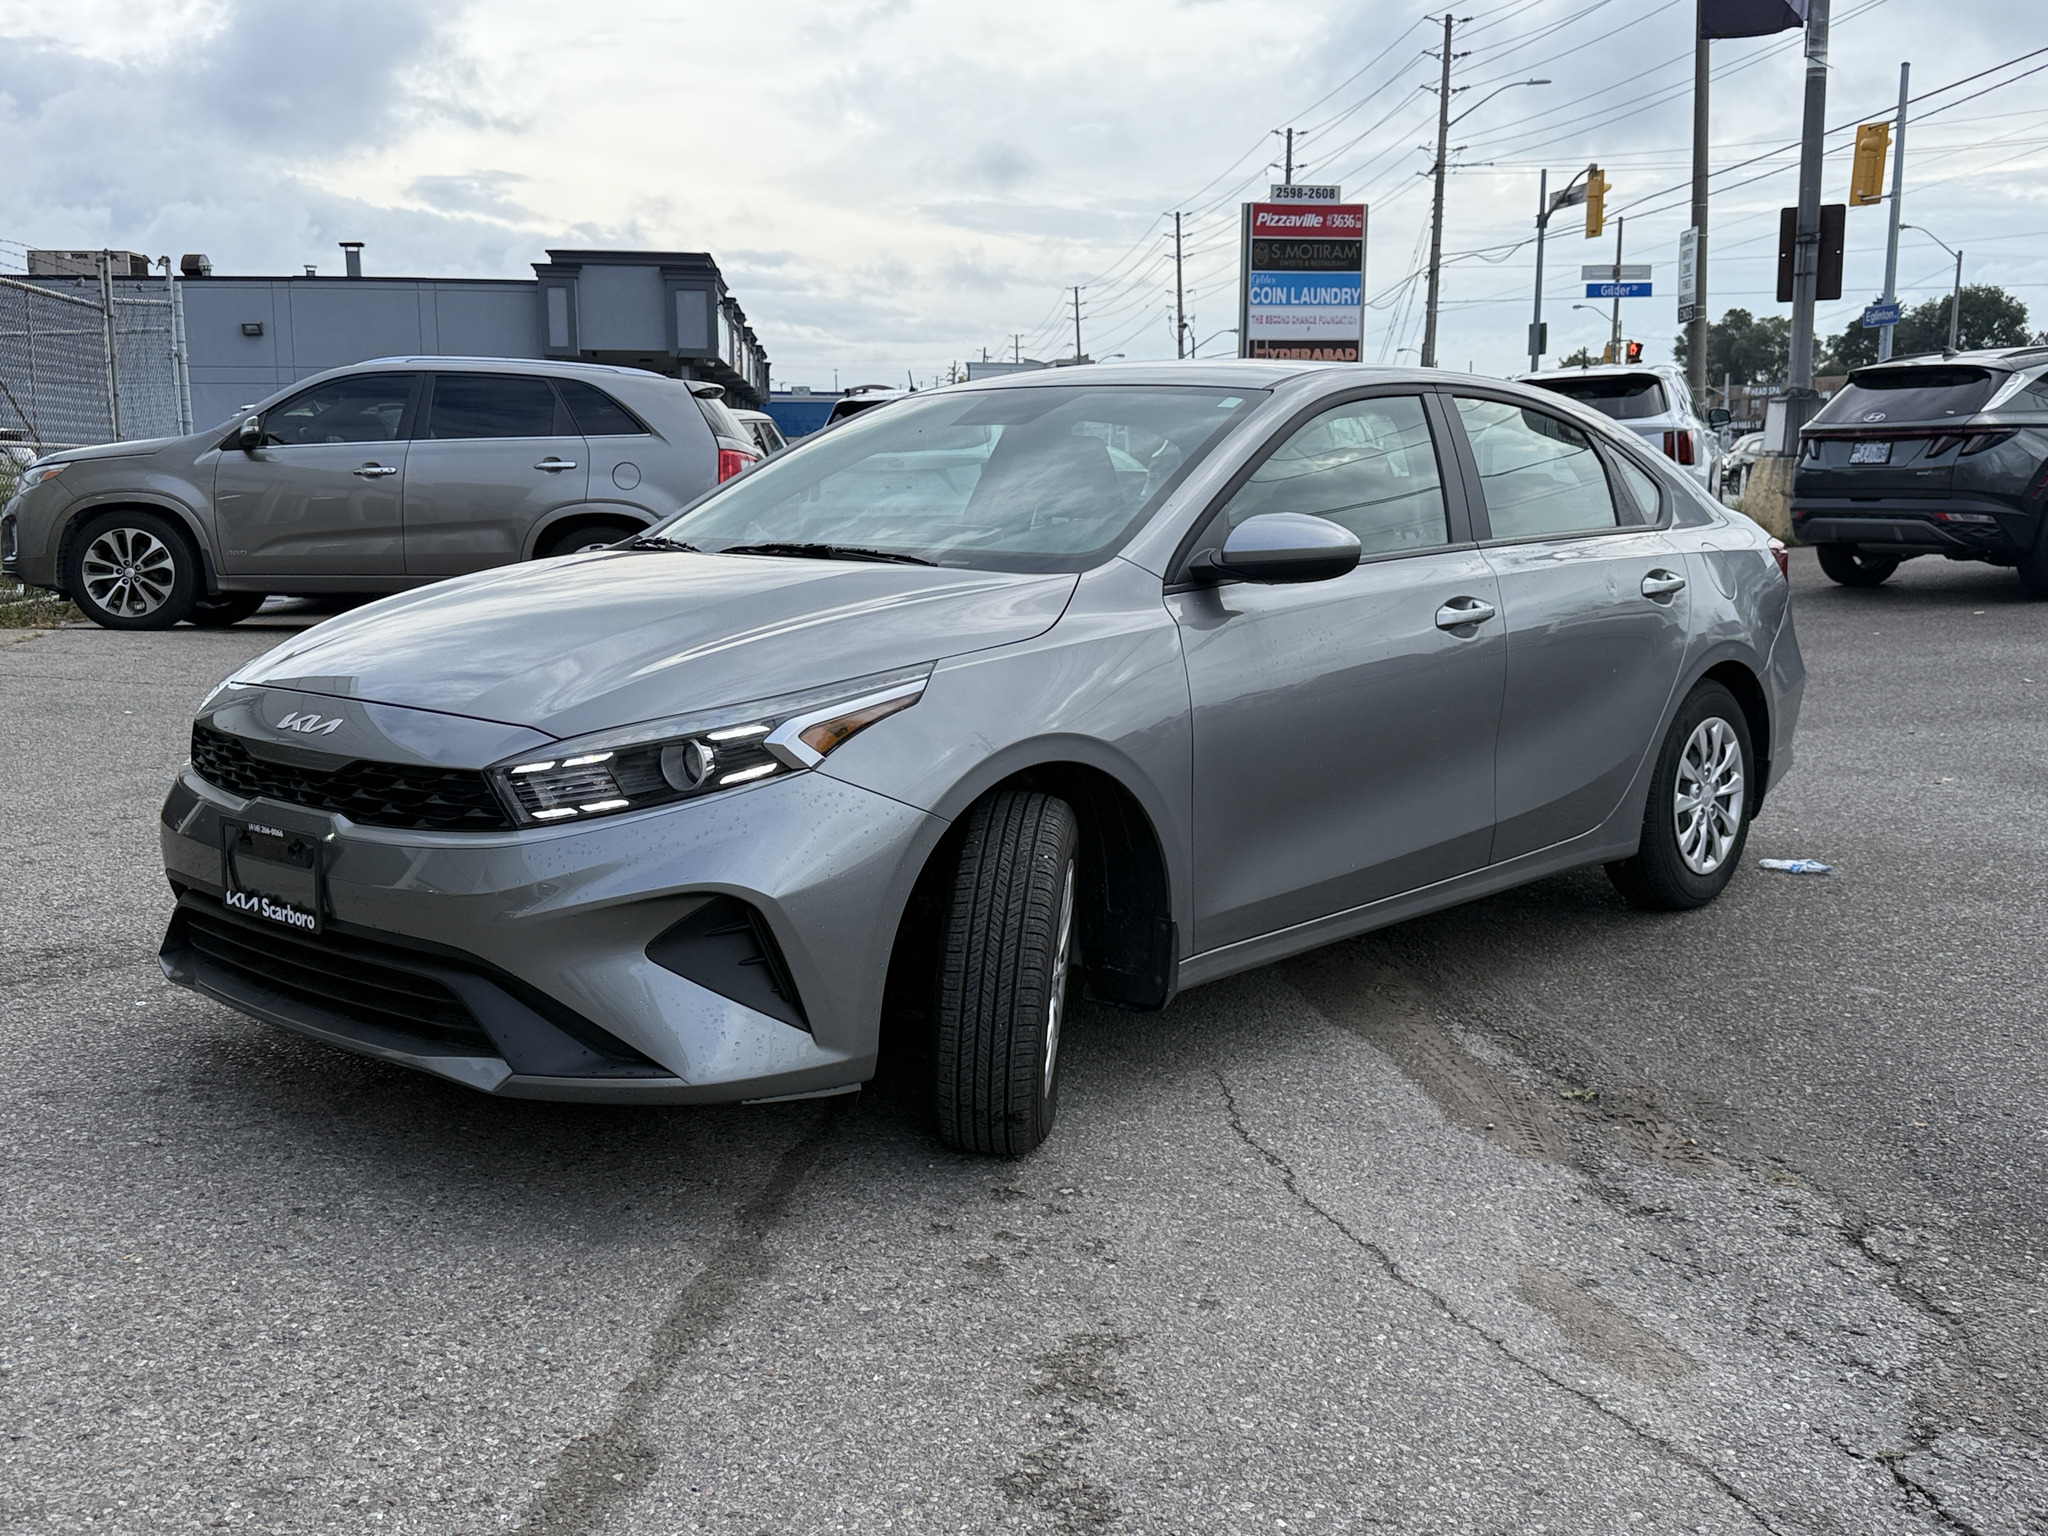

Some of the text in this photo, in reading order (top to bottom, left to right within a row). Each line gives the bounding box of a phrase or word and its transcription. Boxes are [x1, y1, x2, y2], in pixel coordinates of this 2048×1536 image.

[1276, 187, 1335, 199] 2598-2608
[1256, 212, 1323, 227] Pizzaville
[1250, 286, 1360, 304] COIN LAUNDRY
[1600, 285, 1631, 296] Gilder
[1251, 314, 1357, 325] THE SECOND CHANCE FOUNDATION
[1865, 311, 1894, 324] Eglinton
[1750, 386, 1781, 396] HEAD SPA
[276, 711, 344, 736] KIA
[226, 890, 315, 930] KIA Scarboro
